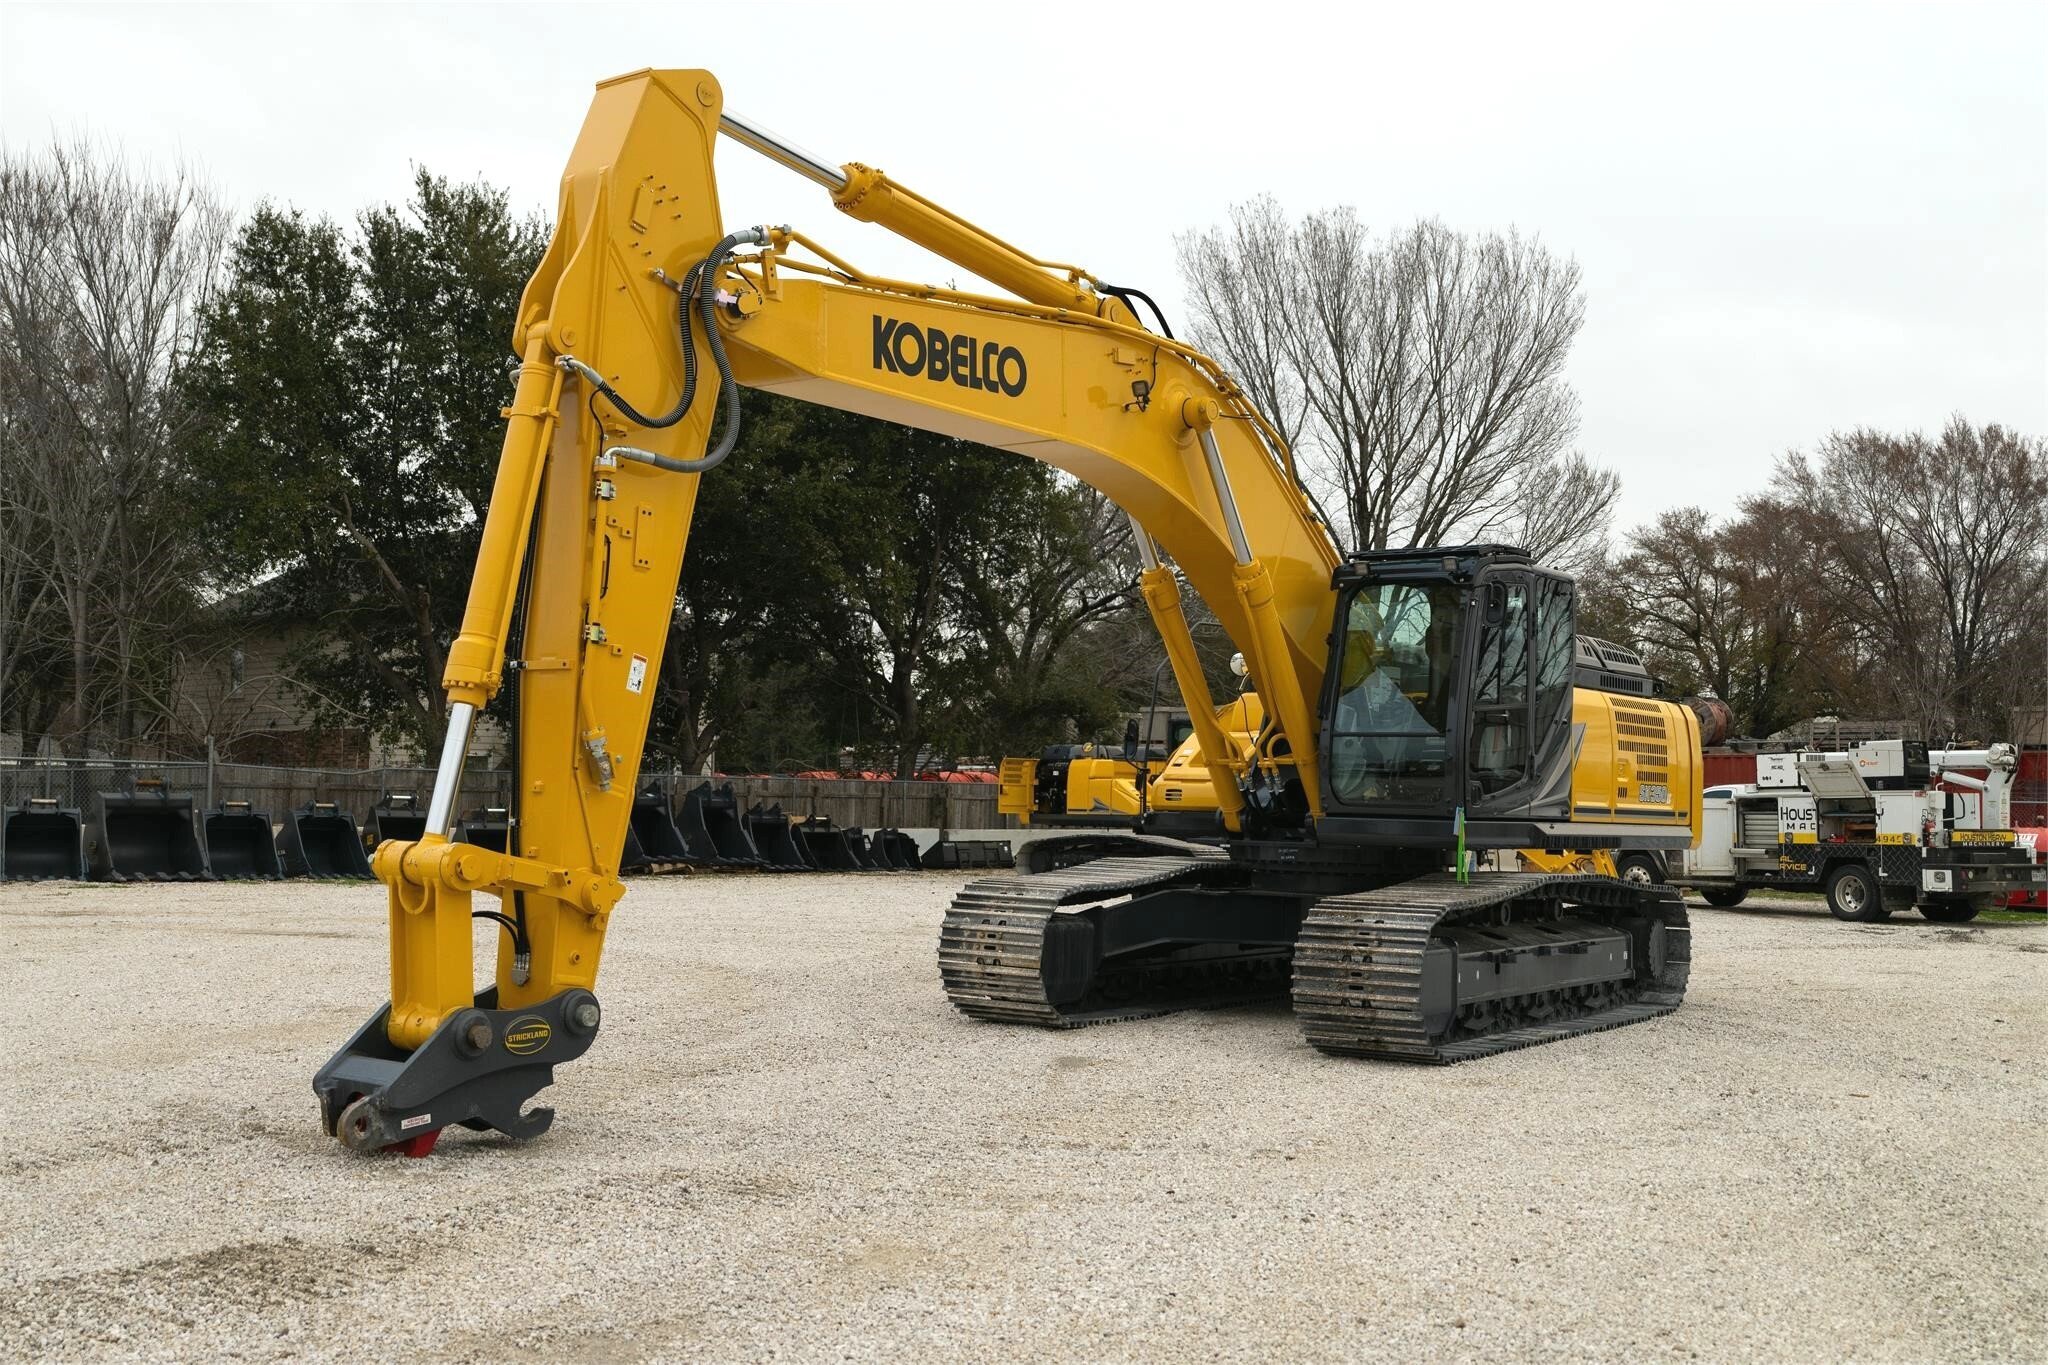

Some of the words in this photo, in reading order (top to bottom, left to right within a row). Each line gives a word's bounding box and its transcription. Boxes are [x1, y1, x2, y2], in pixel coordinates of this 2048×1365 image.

[873, 314, 1027, 398] KOBELCO
[1960, 832, 1987, 841] HOUSTON
[1988, 832, 2007, 841] HEAVY
[1780, 863, 1807, 871] RVICE
[507, 1029, 548, 1043] STRICKLAND
